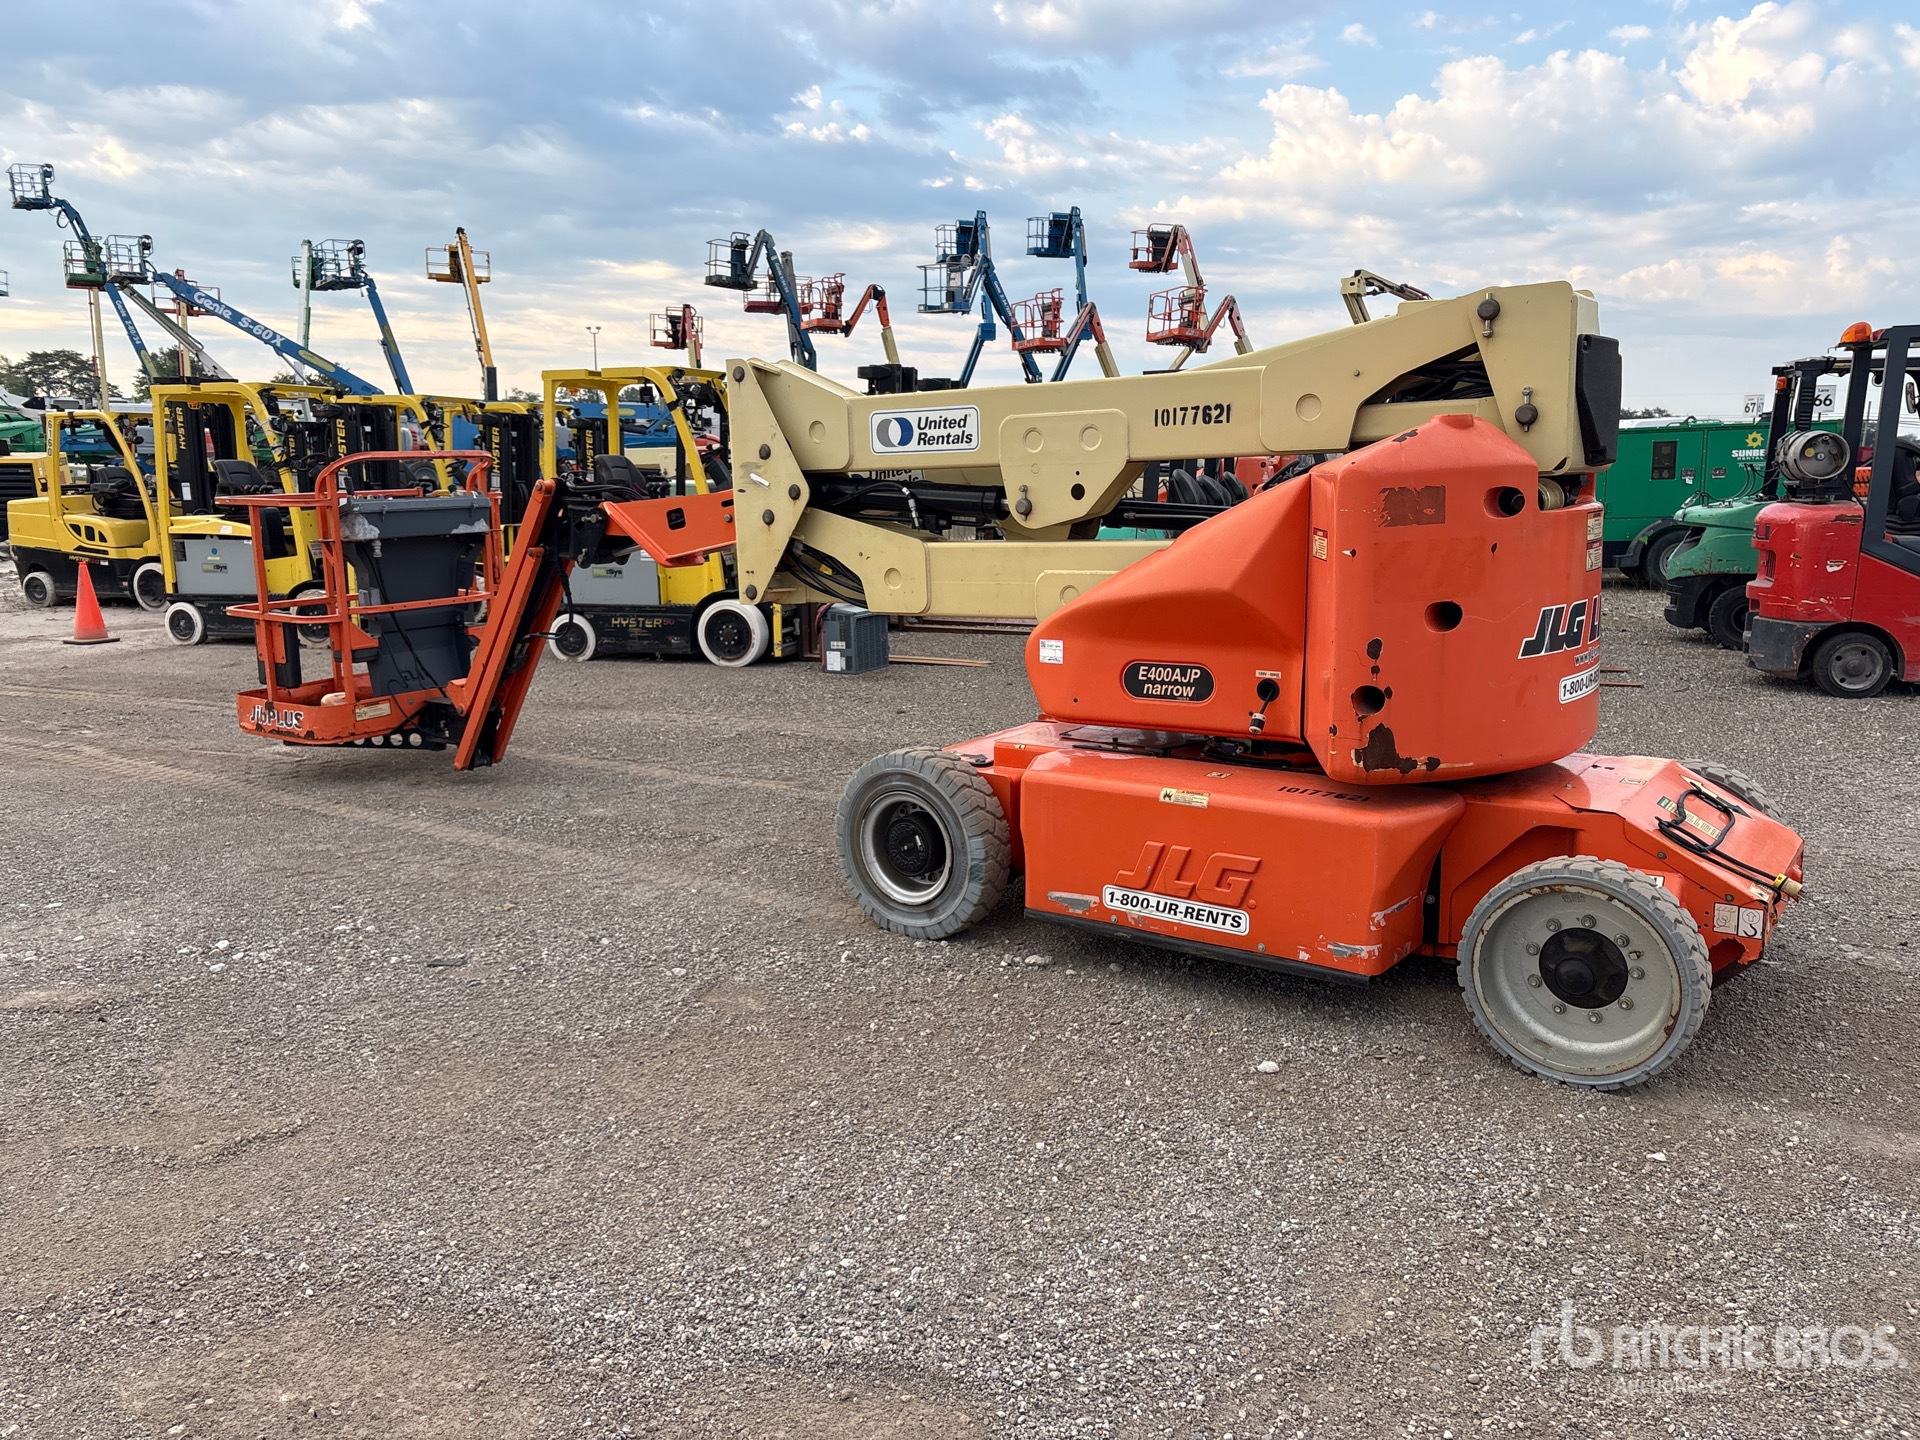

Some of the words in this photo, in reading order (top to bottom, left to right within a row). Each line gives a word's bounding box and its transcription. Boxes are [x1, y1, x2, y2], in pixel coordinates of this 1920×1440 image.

[115, 300, 127, 318] Genie
[193, 291, 233, 320] Genie
[1744, 402, 1756, 413] 67
[1814, 394, 1832, 407] 66
[917, 414, 967, 430] United
[1154, 403, 1231, 427] 10177621
[176, 407, 187, 450] HYSTER
[917, 430, 973, 446] Rentals
[492, 427, 500, 473] HYSTER
[586, 430, 594, 471] HYSTER
[1731, 449, 1765, 457] SUNBE
[612, 617, 662, 628] HYSTER
[1518, 599, 1588, 659] JLG
[1138, 666, 1201, 683] E400AJP
[1143, 682, 1195, 697] narrow
[1277, 786, 1371, 802] 10177621
[1113, 841, 1262, 907] JLG
[1108, 891, 1242, 929] 1-800-UR-RENTS
